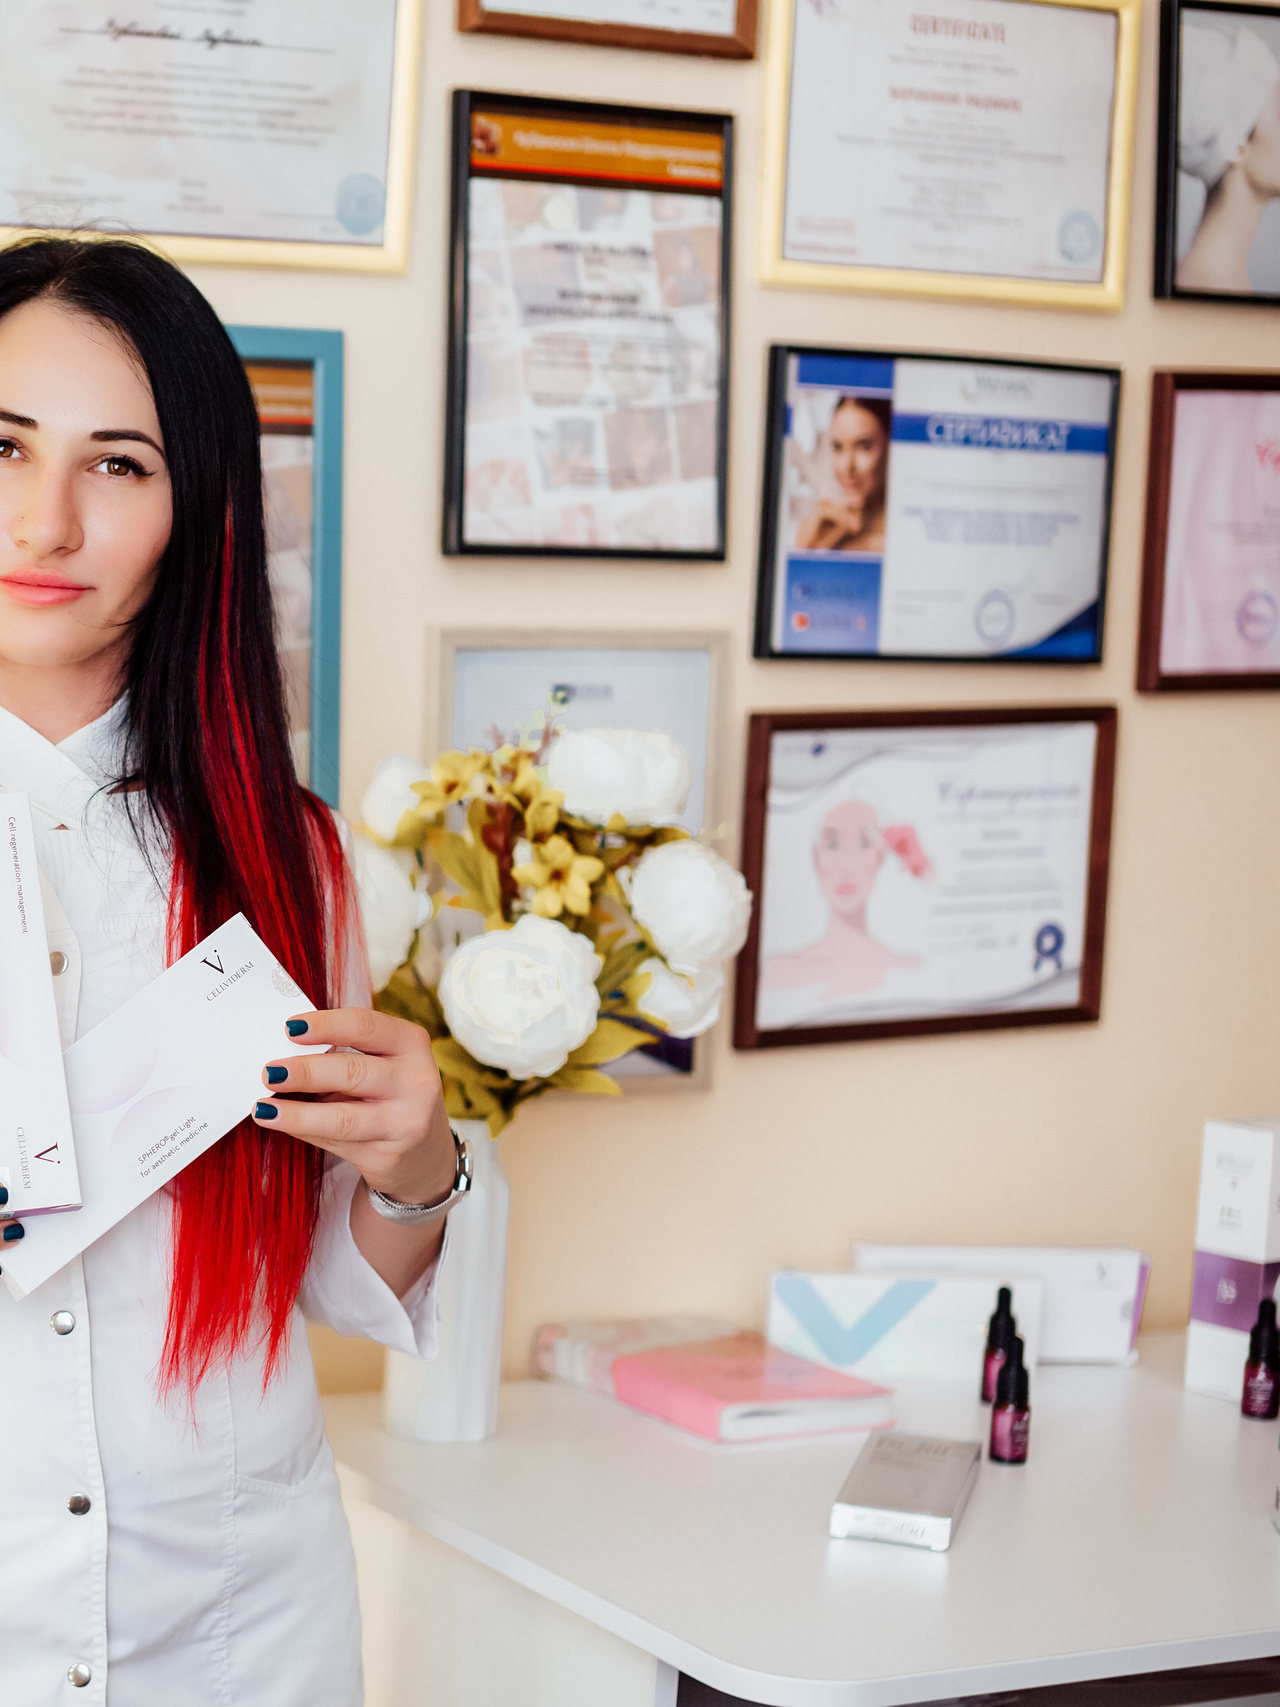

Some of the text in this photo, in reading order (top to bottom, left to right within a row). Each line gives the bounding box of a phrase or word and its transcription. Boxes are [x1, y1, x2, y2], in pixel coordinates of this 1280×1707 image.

[8, 816, 28, 934] Cell regeneration management
[206, 961, 255, 1002] CELLVIDERM
[140, 1122, 209, 1178] for aesthetic medicine
[178, 1116, 196, 1132] Light
[16, 1126, 31, 1189] CELLVIDERM
